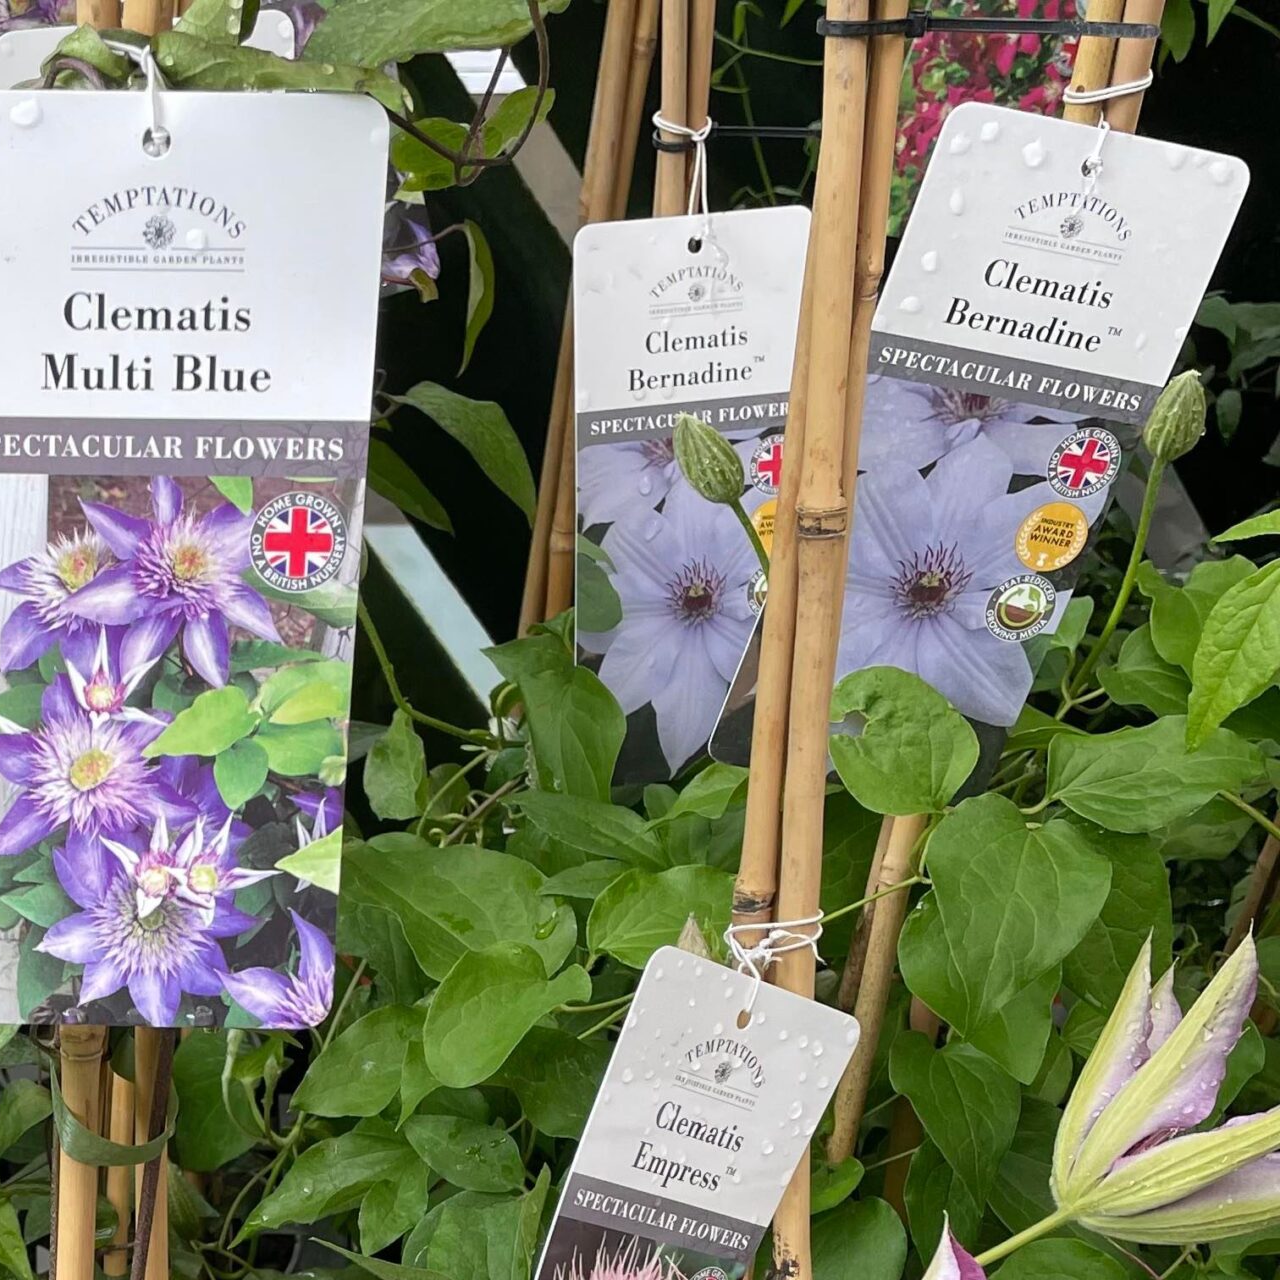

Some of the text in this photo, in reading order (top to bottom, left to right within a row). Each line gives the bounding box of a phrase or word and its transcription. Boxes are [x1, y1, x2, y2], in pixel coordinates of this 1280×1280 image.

[72, 185, 246, 240] TEMPTATIONS
[1014, 192, 1132, 243] TEMPTATIONS
[71, 254, 245, 265] IRRESISTIBLE GARDEN PLANTS
[649, 266, 744, 299] TEMPTATIONS
[984, 258, 1114, 310] Clematis
[63, 291, 251, 332] Clematis
[646, 325, 748, 355] Clematis
[41, 353, 271, 392] Multi Blue
[878, 346, 1143, 412] SPECTACULAR FLOWERS
[590, 402, 789, 436] SPECTACUAR FLOWER
[194, 436, 344, 462] FLOWERS
[1049, 452, 1060, 468] ON
[1061, 429, 1119, 458] HOME GROWN
[1051, 478, 1079, 497] BRITISH
[1081, 463, 1117, 496] NURSERY
[257, 494, 341, 529] HOME GROWN
[1040, 517, 1075, 529] INDUSTRY
[1030, 533, 1071, 548] WINNER
[1034, 524, 1074, 539] AWARD
[252, 534, 345, 590] ON A BRITISH NURSERY
[986, 609, 1048, 640] GROWING MEDIA
[684, 1038, 766, 1089] TEMPTATIONS
[655, 1100, 744, 1153] Clematis
[574, 1188, 751, 1251] SPECTACULAR FLOWERS
